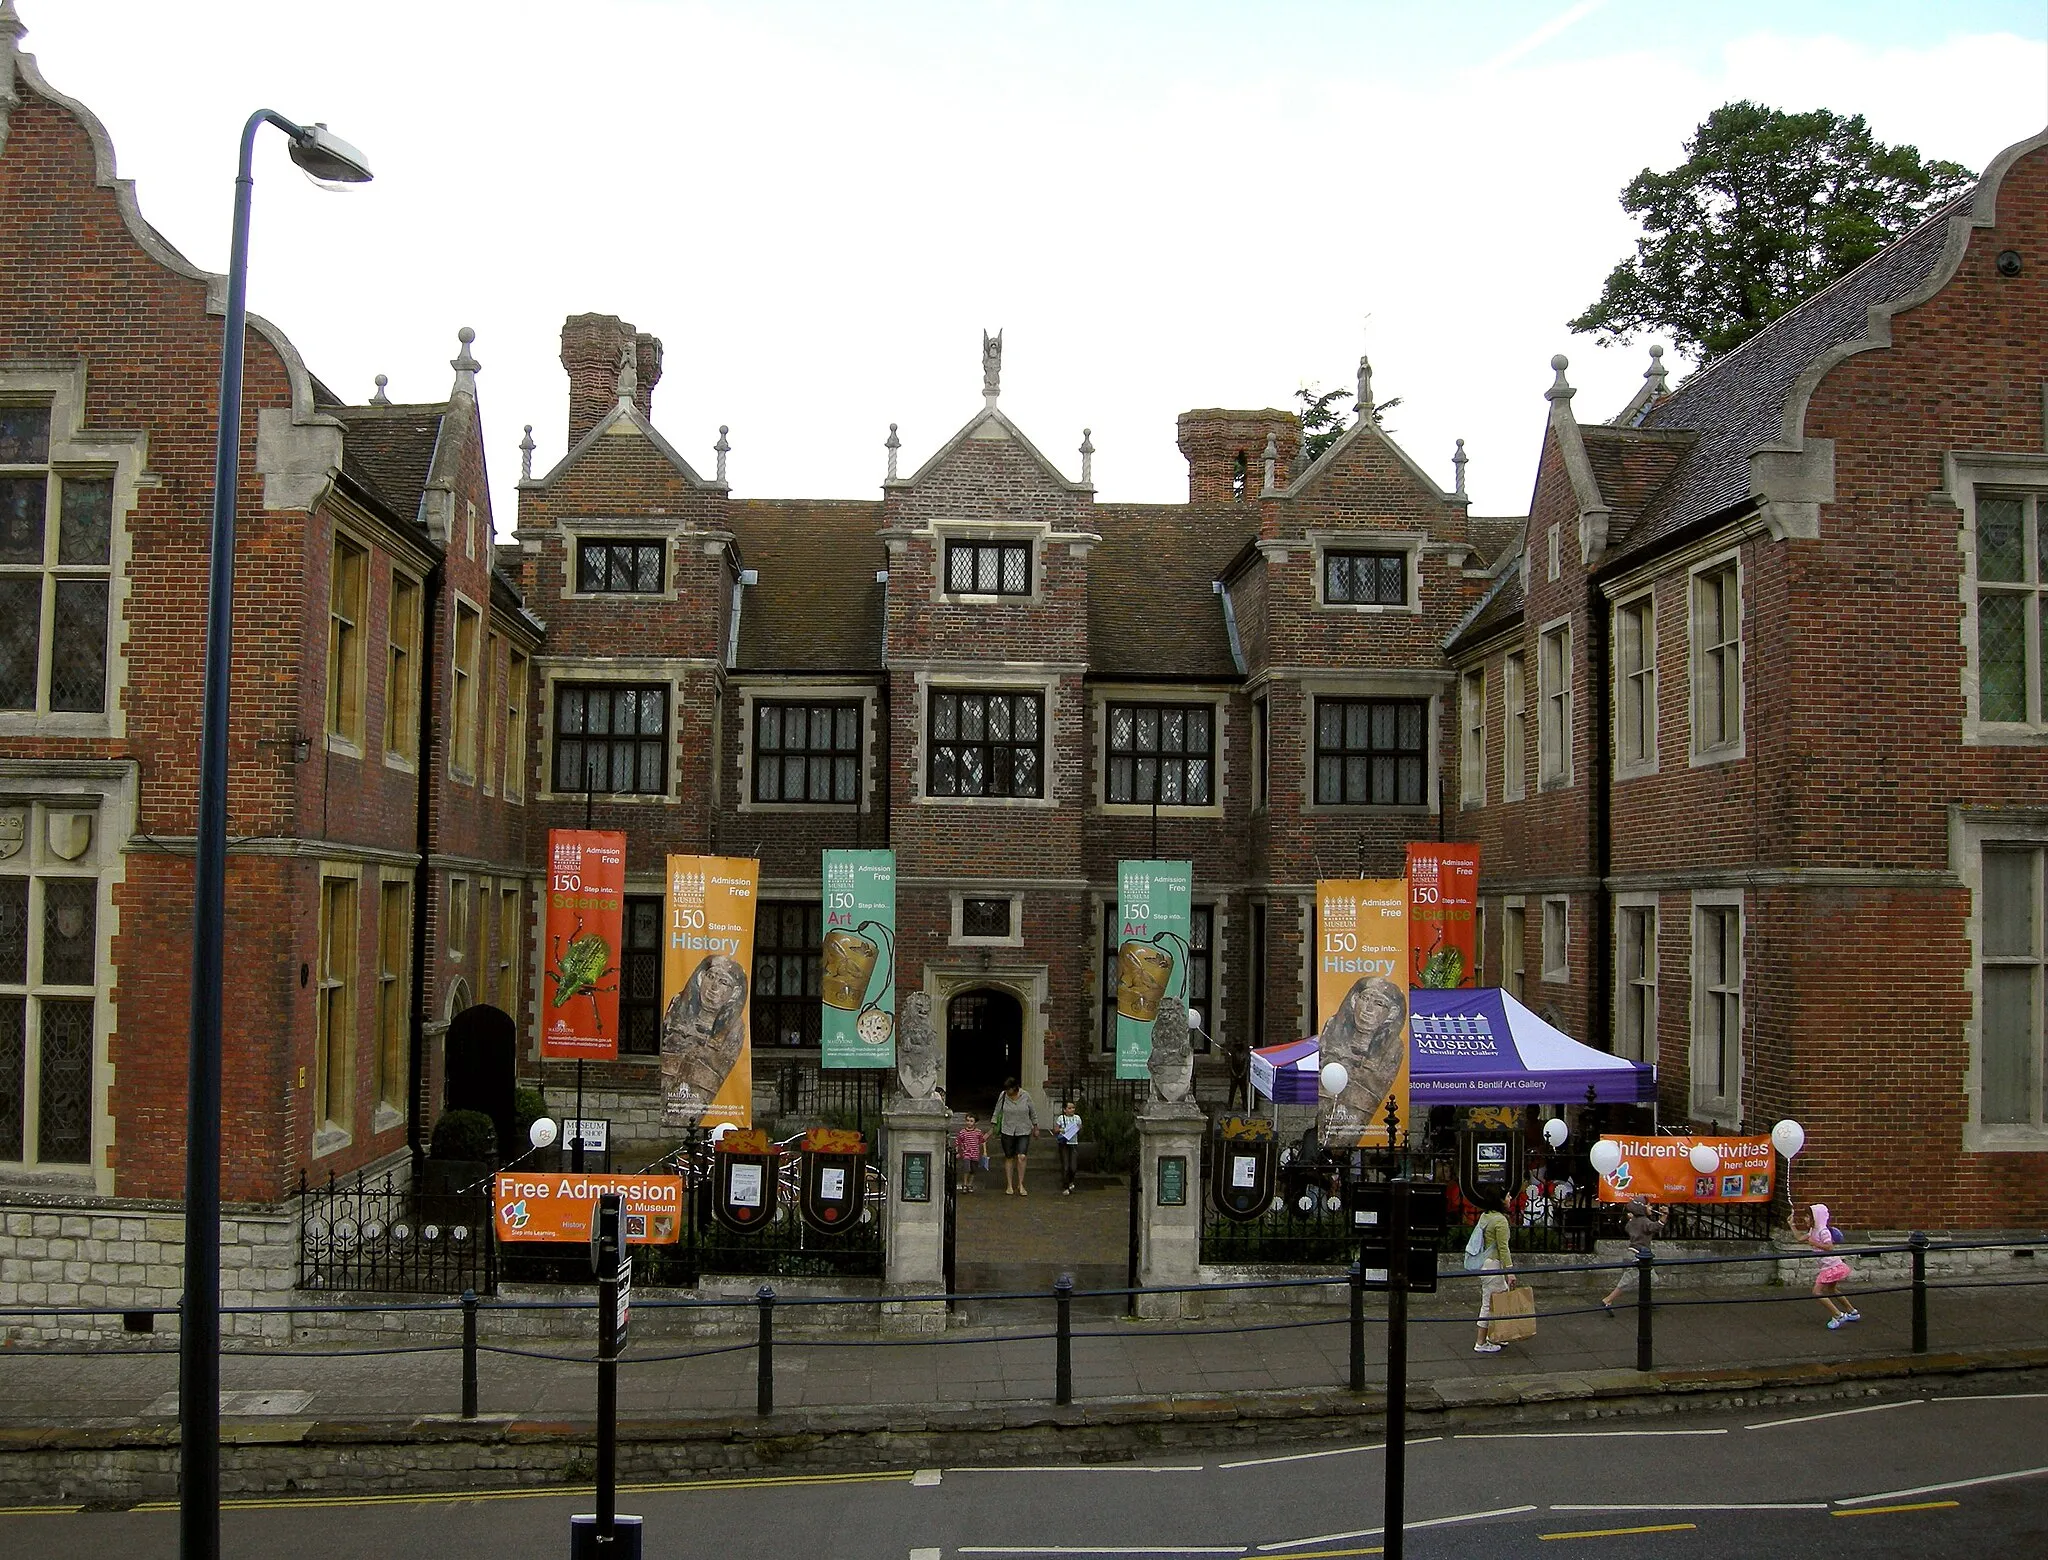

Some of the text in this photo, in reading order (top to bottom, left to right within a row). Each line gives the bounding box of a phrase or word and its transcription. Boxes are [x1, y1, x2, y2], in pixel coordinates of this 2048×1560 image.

[586, 847, 620, 855] Admission
[601, 855, 620, 864] Free
[1456, 867, 1473, 875] Free
[553, 874, 581, 891] 150
[710, 876, 751, 886] Admission
[584, 885, 600, 893] Step
[729, 887, 750, 897] Free
[1169, 884, 1186, 892] Free
[673, 896, 705, 904] MUSEUM
[828, 893, 854, 909] 150
[1412, 887, 1439, 904] 150
[552, 893, 617, 910] Science
[858, 902, 872, 910] Step
[1361, 899, 1402, 907] Admission
[1123, 903, 1150, 919] 150
[1381, 908, 1402, 917] Free
[1412, 906, 1471, 921] Science
[673, 909, 705, 929] 150
[827, 911, 852, 925] Art
[708, 922, 726, 931] Step
[1123, 921, 1148, 936] Art
[671, 932, 740, 956] History
[1324, 932, 1357, 952] 150
[1361, 945, 1380, 953] Step
[1323, 956, 1396, 977] History
[1416, 1039, 1498, 1050] MUSEUM
[1409, 1079, 1547, 1090] stone Museum & Bentlif Art Gallery
[566, 1121, 605, 1130] MSEUM
[1615, 1142, 1769, 1157] hildren's tivities
[1724, 1159, 1769, 1170] here today
[501, 1178, 676, 1201] Free Admission
[1663, 1184, 1686, 1192] History
[626, 1202, 676, 1213] o Museum
[562, 1221, 587, 1230] History
